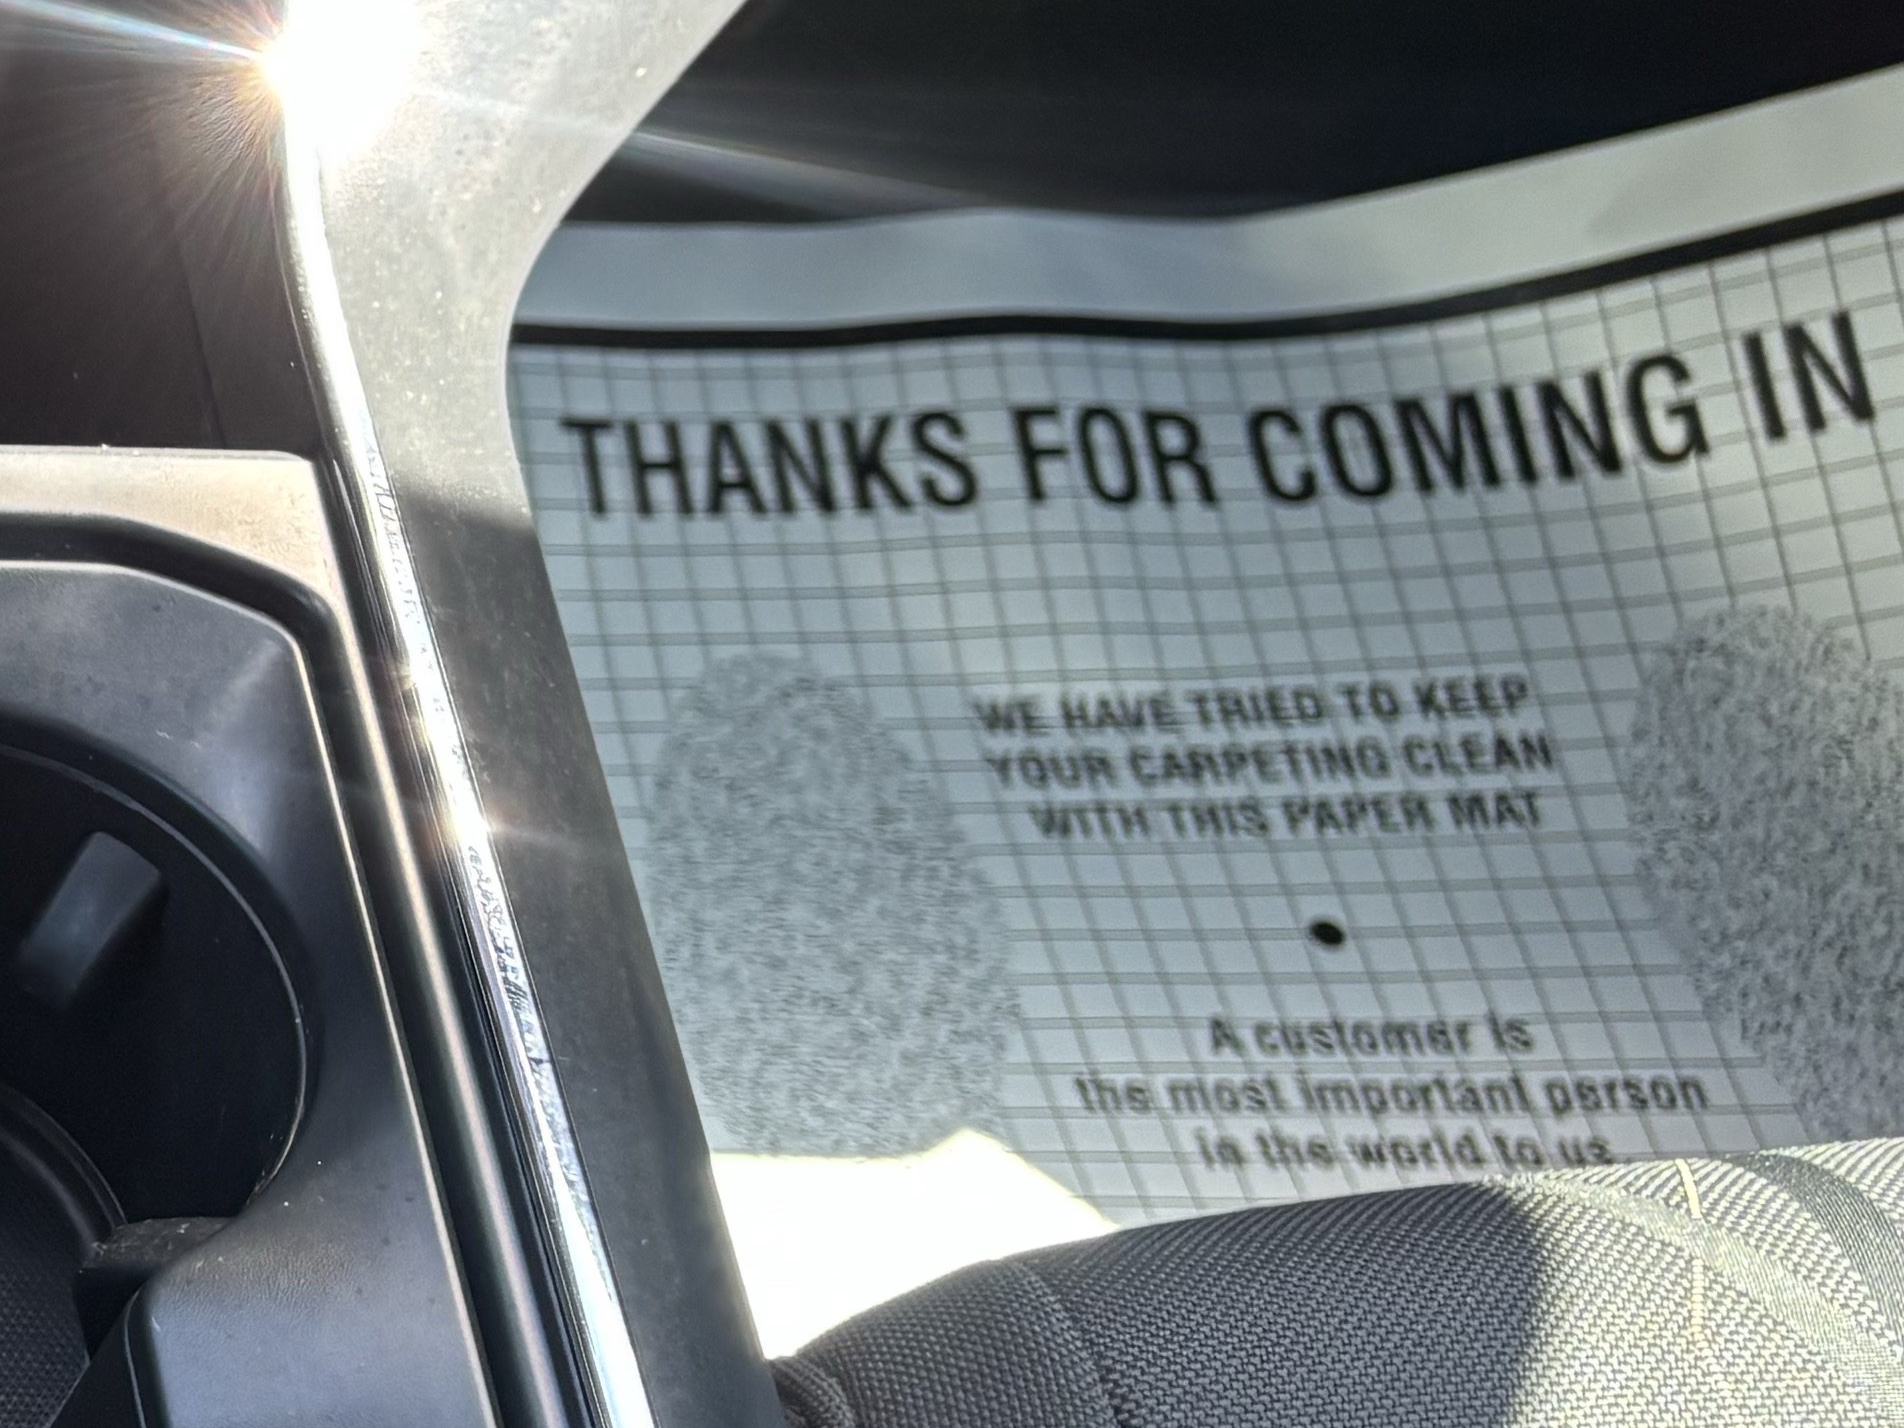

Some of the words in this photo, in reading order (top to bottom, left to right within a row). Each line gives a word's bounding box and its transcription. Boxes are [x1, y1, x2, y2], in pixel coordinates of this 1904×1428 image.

[559, 409, 979, 519] THANKS
[1010, 404, 1219, 510] FOR
[1246, 351, 1712, 506] COMING
[1742, 308, 1876, 444] IN
[973, 693, 1049, 736] WE
[1060, 689, 1180, 733] HAVE
[1187, 682, 1324, 729] TRIED
[1337, 679, 1402, 722] TO
[1412, 673, 1530, 719] KEEP
[989, 744, 1117, 790] YOUR
[1129, 734, 1392, 788] CARPETING
[1402, 728, 1554, 777] CLEAN
[1028, 800, 1152, 841] WITH
[1165, 797, 1270, 839] THIS
[1280, 791, 1436, 836] PAPER
[1447, 788, 1544, 832] MAT
[1207, 1014, 1242, 1057] A
[1252, 1014, 1473, 1059] customer
[1488, 1012, 1537, 1055] is
[1074, 1072, 1151, 1115] the
[1166, 1074, 1287, 1115] most
[1296, 1068, 1531, 1120] important
[1543, 1074, 1712, 1120] person
[1194, 1128, 1245, 1172] in
[1255, 1127, 1330, 1171] the
[1347, 1128, 1487, 1172] world
[1495, 1128, 1545, 1170] to
[1558, 1131, 1614, 1169] us
